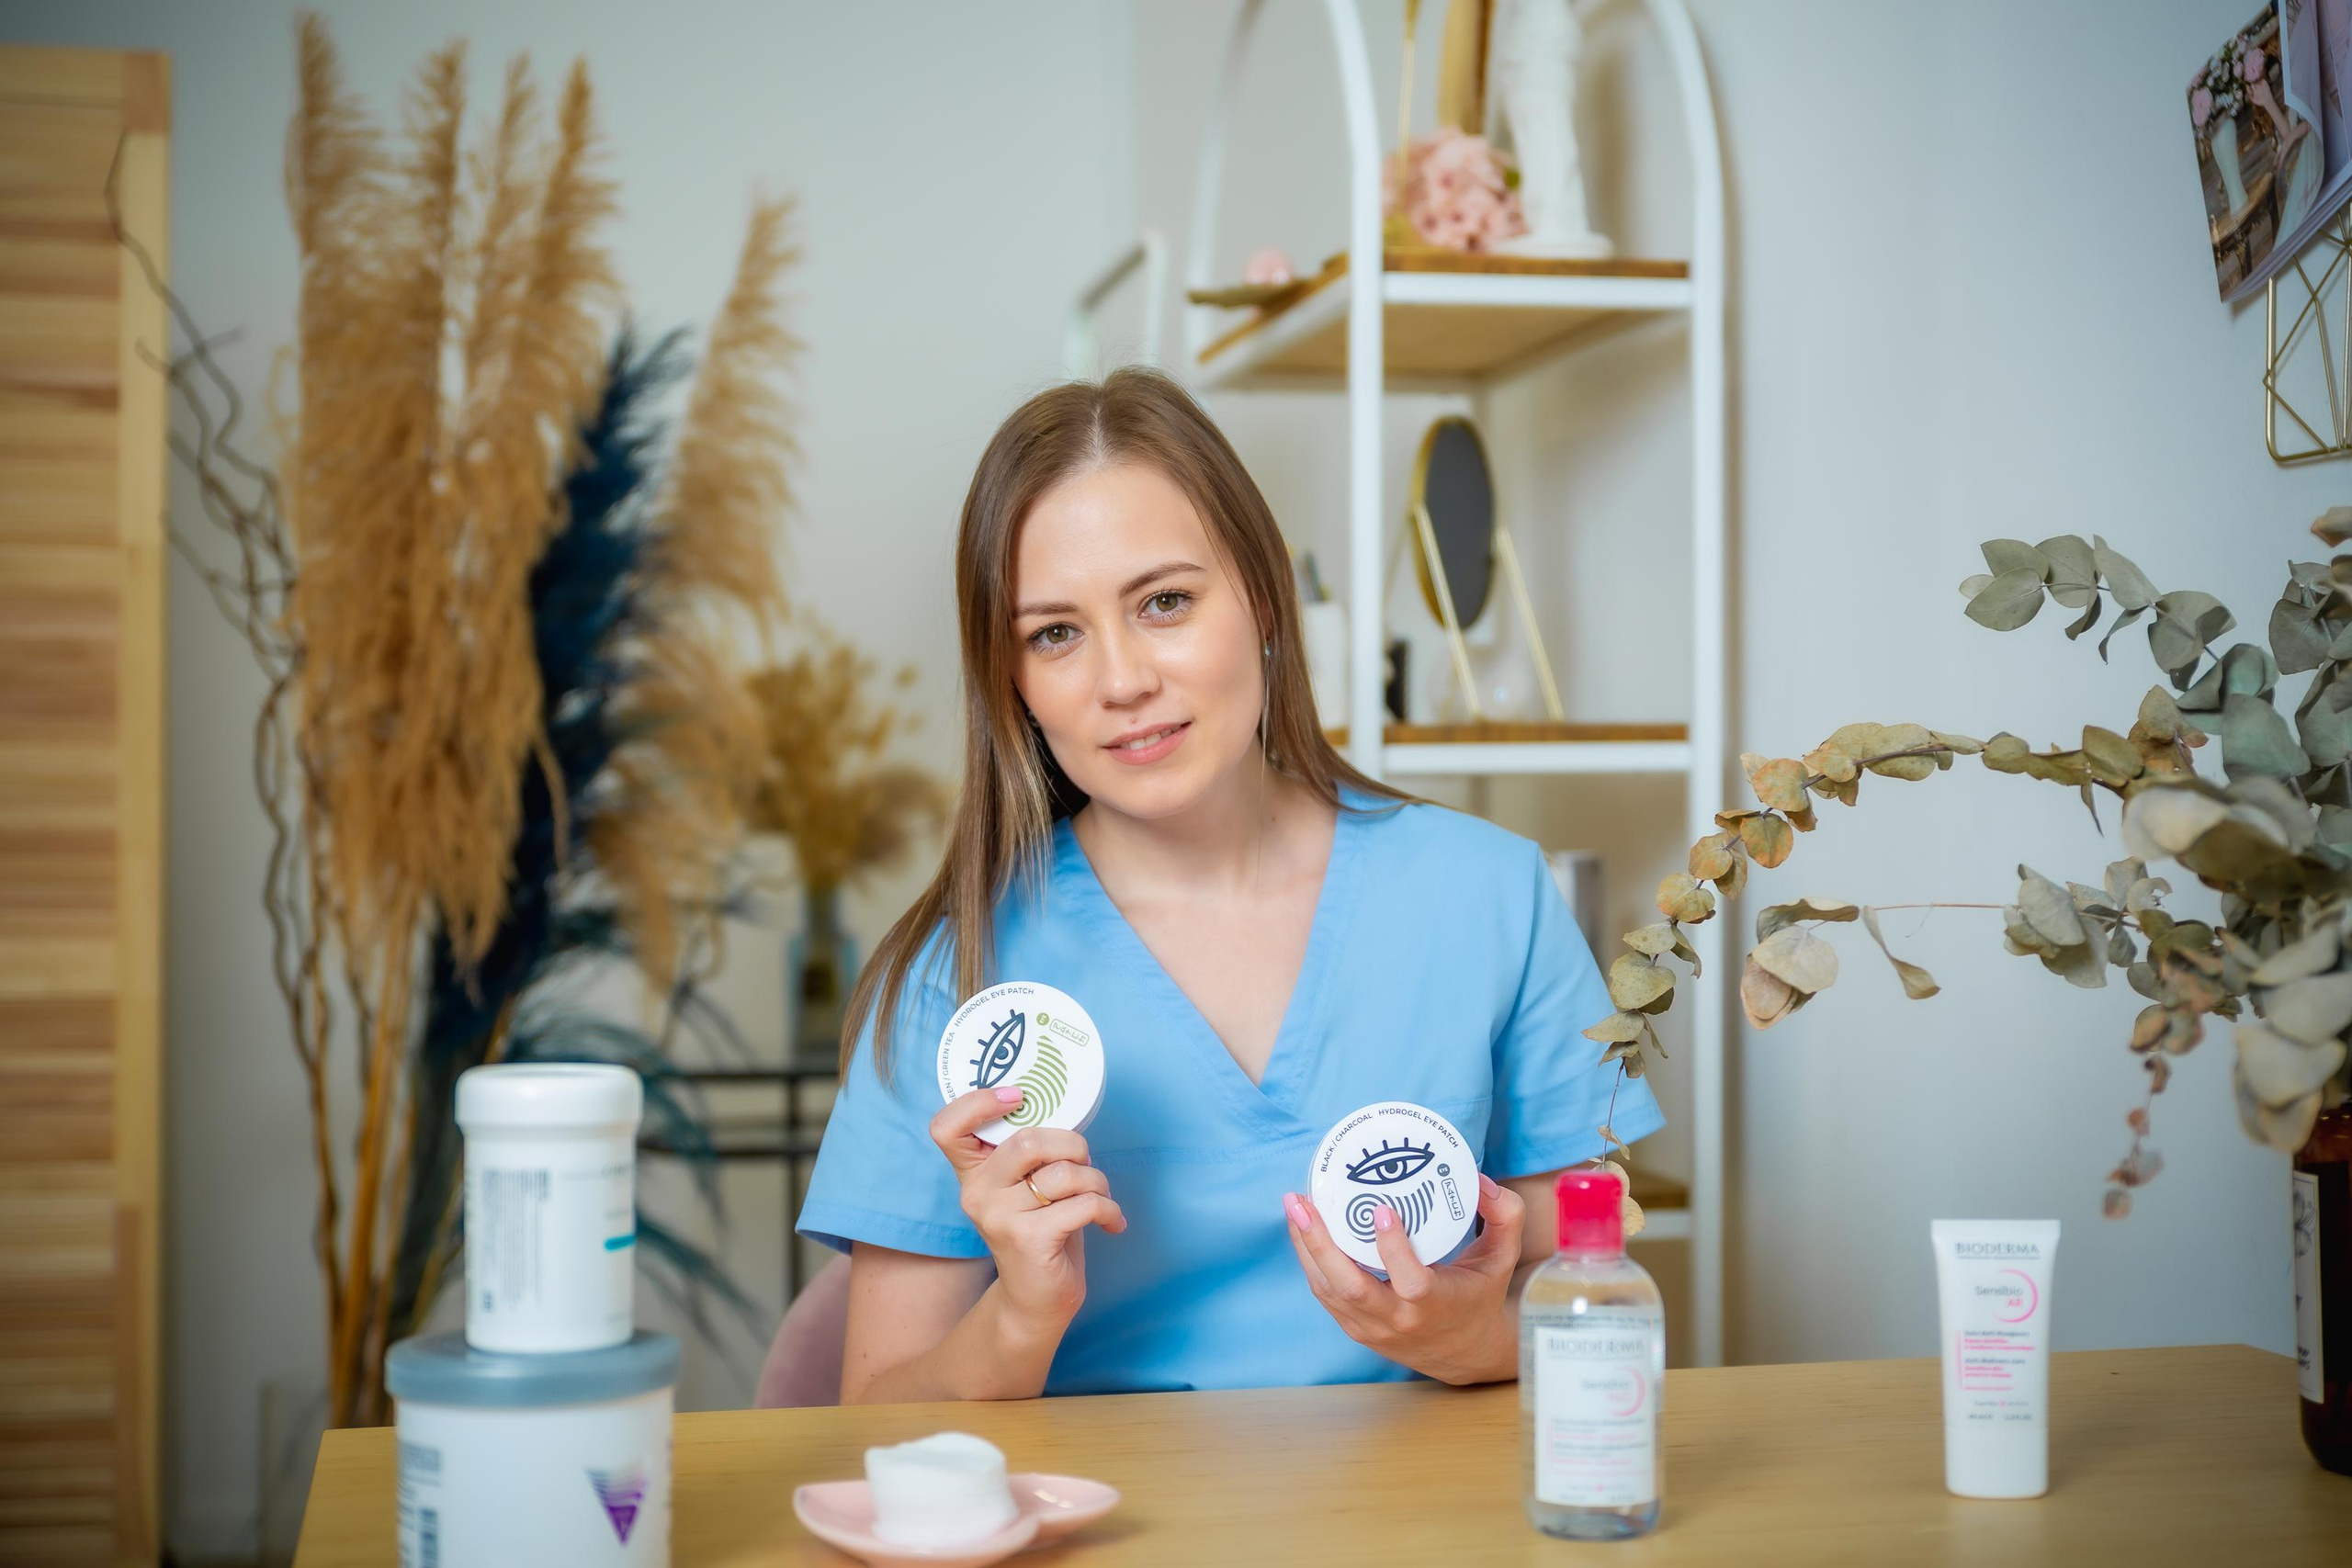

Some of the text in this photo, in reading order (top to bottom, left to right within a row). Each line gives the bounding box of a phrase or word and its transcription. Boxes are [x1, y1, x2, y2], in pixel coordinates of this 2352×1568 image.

[945, 1032, 955, 1046] TEA
[954, 995, 990, 1027] HYDROGEL
[990, 989, 1006, 999] EYE
[1320, 1146, 1335, 1173] BLACK
[1335, 1112, 1374, 1143] CHARCOAL
[1378, 1108, 1422, 1121] HYDROGEL
[1423, 1115, 1439, 1128] EYE
[1437, 1125, 1459, 1148] PATCH
[1438, 1167, 1449, 1175] EYE
[1955, 1242, 2040, 1254] BIODERMA
